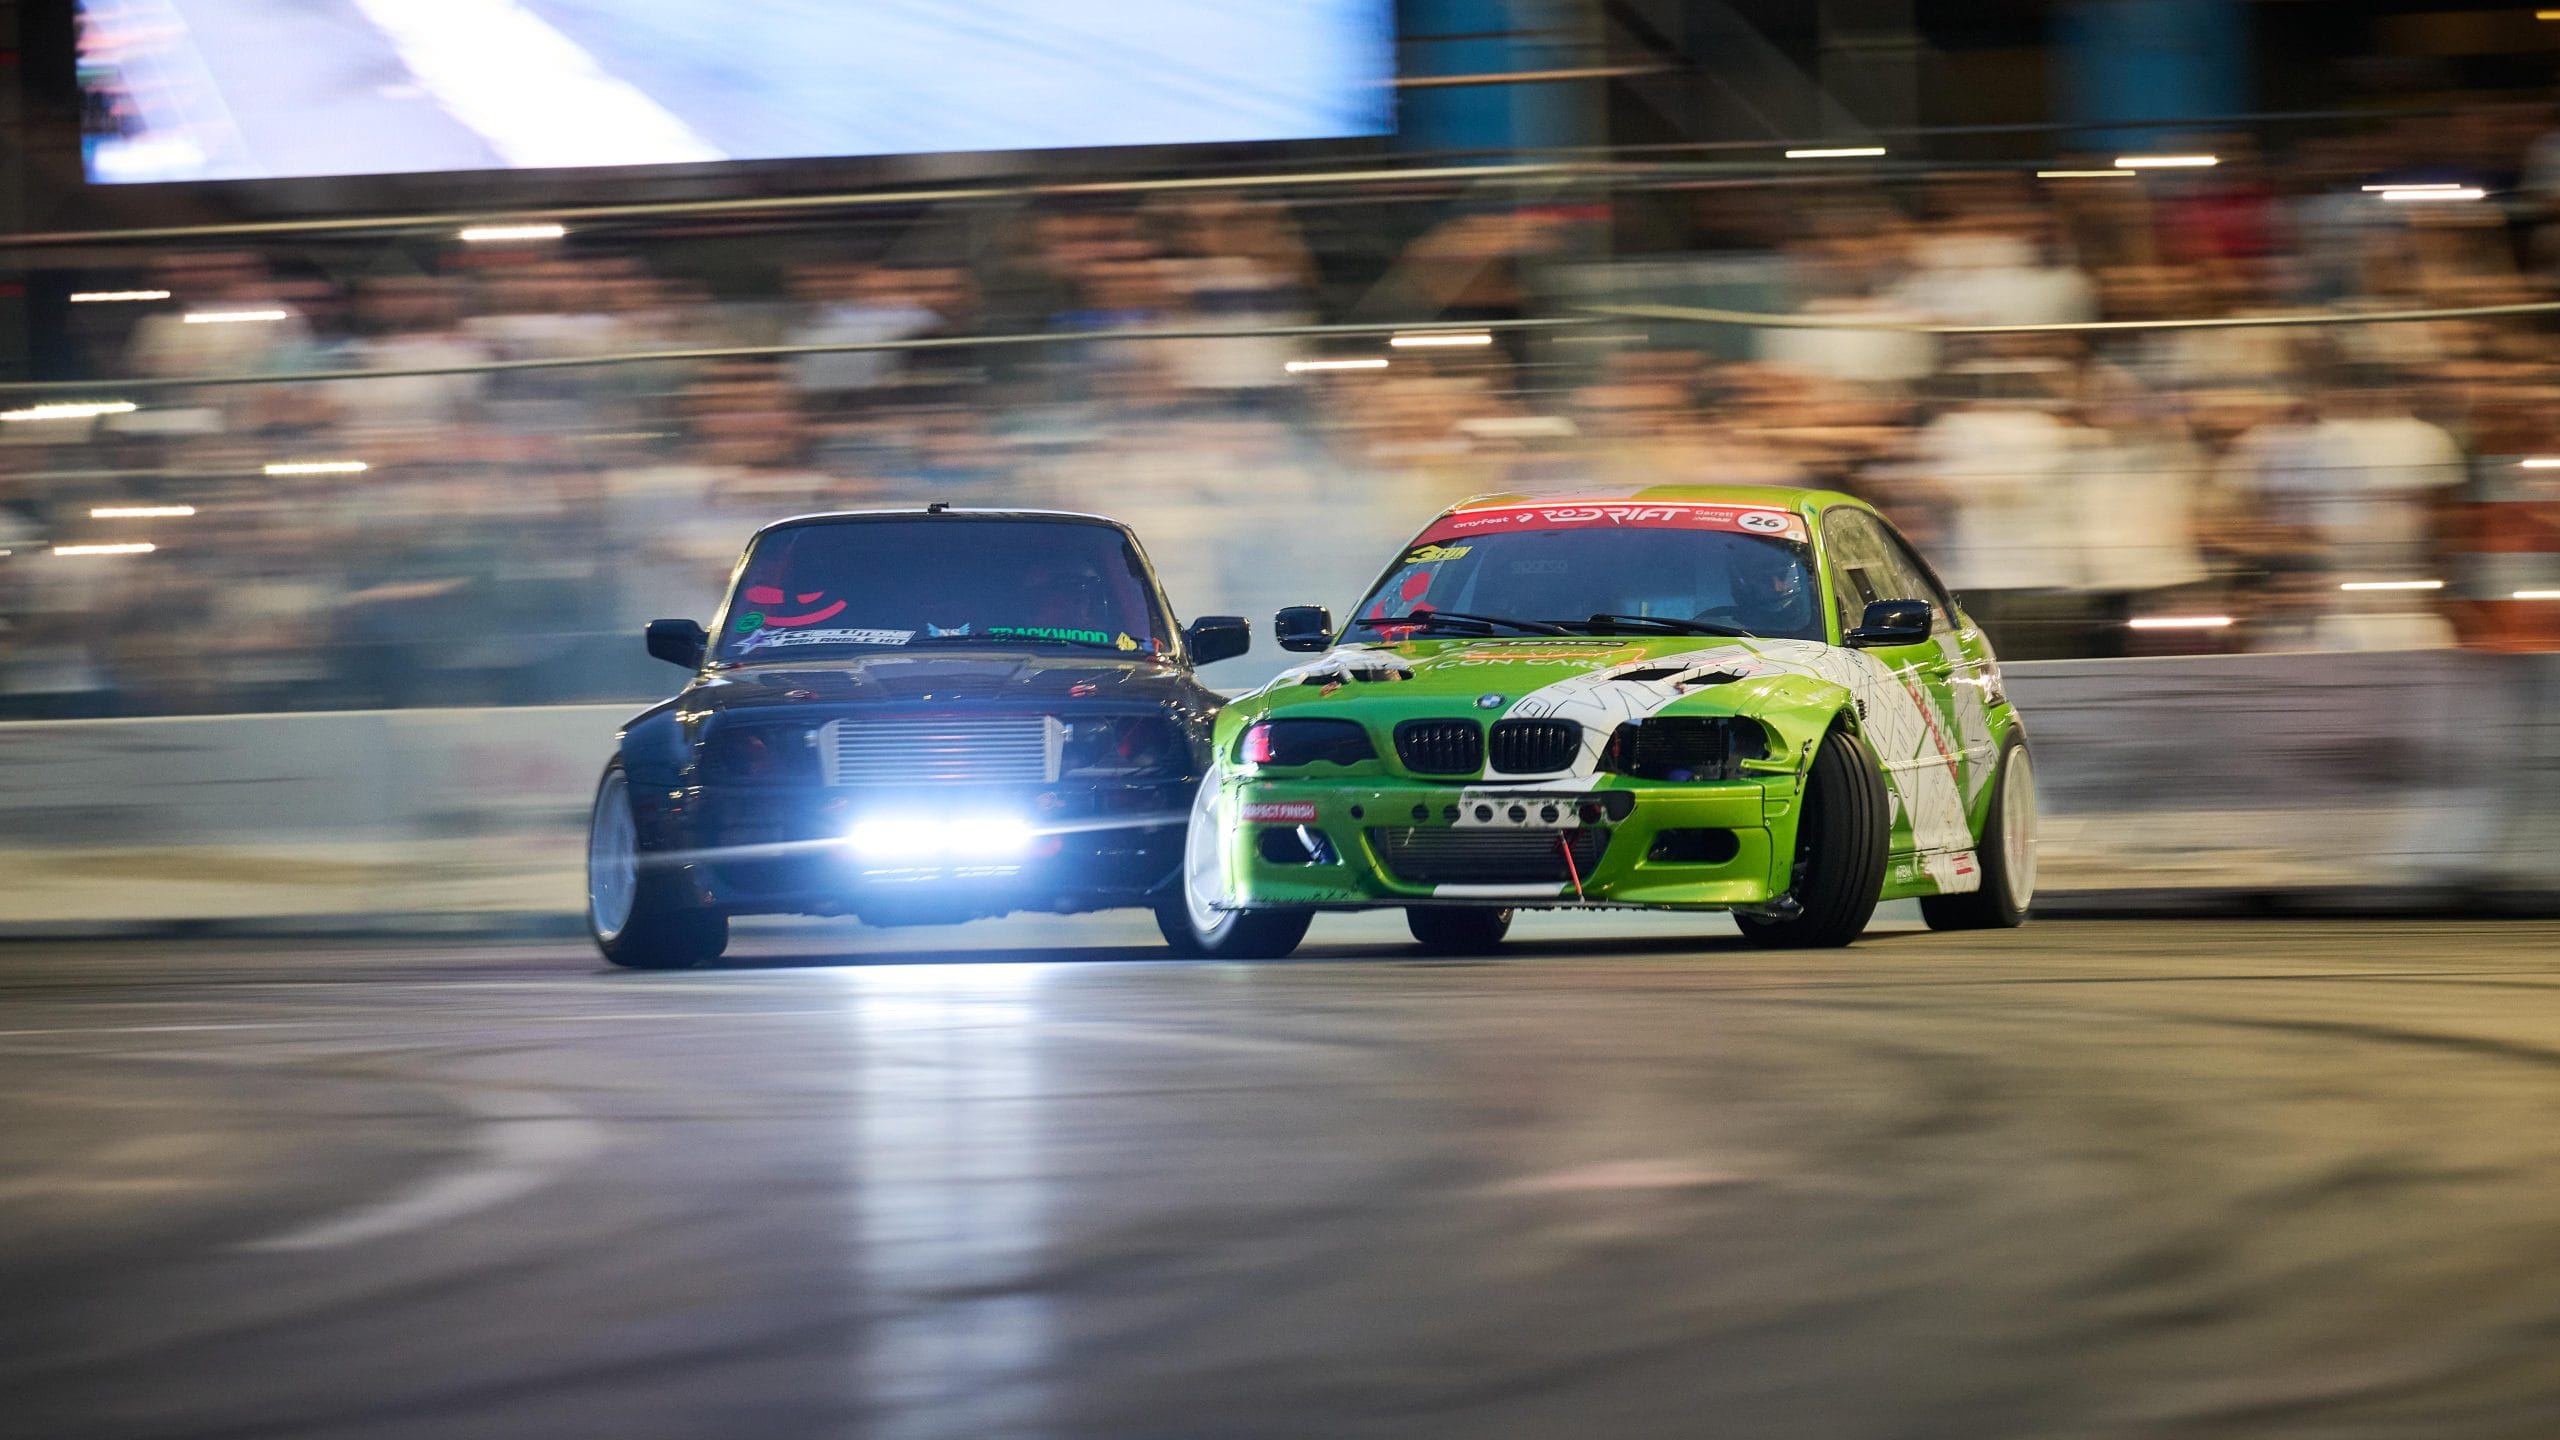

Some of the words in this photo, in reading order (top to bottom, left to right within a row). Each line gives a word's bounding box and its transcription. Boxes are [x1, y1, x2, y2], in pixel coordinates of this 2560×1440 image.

[1694, 509, 1734, 517] Garrett
[1746, 516, 1779, 528] 26
[1425, 658, 1513, 671] ICON
[1524, 657, 1608, 670] CARS
